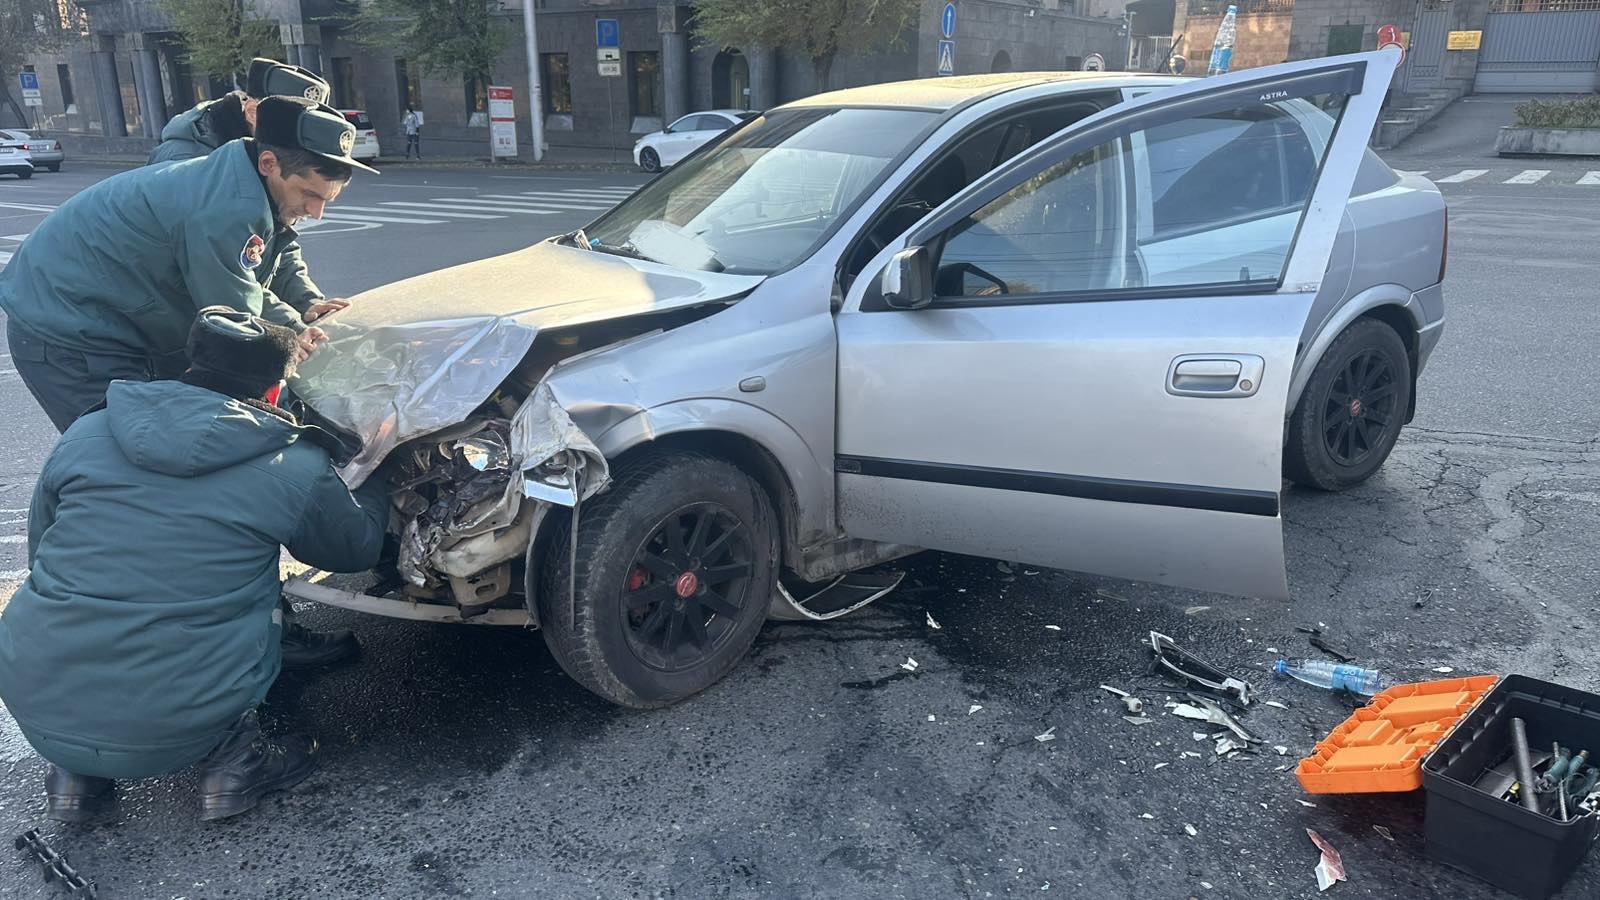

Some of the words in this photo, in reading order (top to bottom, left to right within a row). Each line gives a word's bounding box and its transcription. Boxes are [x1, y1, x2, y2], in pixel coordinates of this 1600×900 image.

[602, 22, 614, 45] P
[24, 74, 33, 87] P
[1259, 90, 1288, 101] ASTRA
